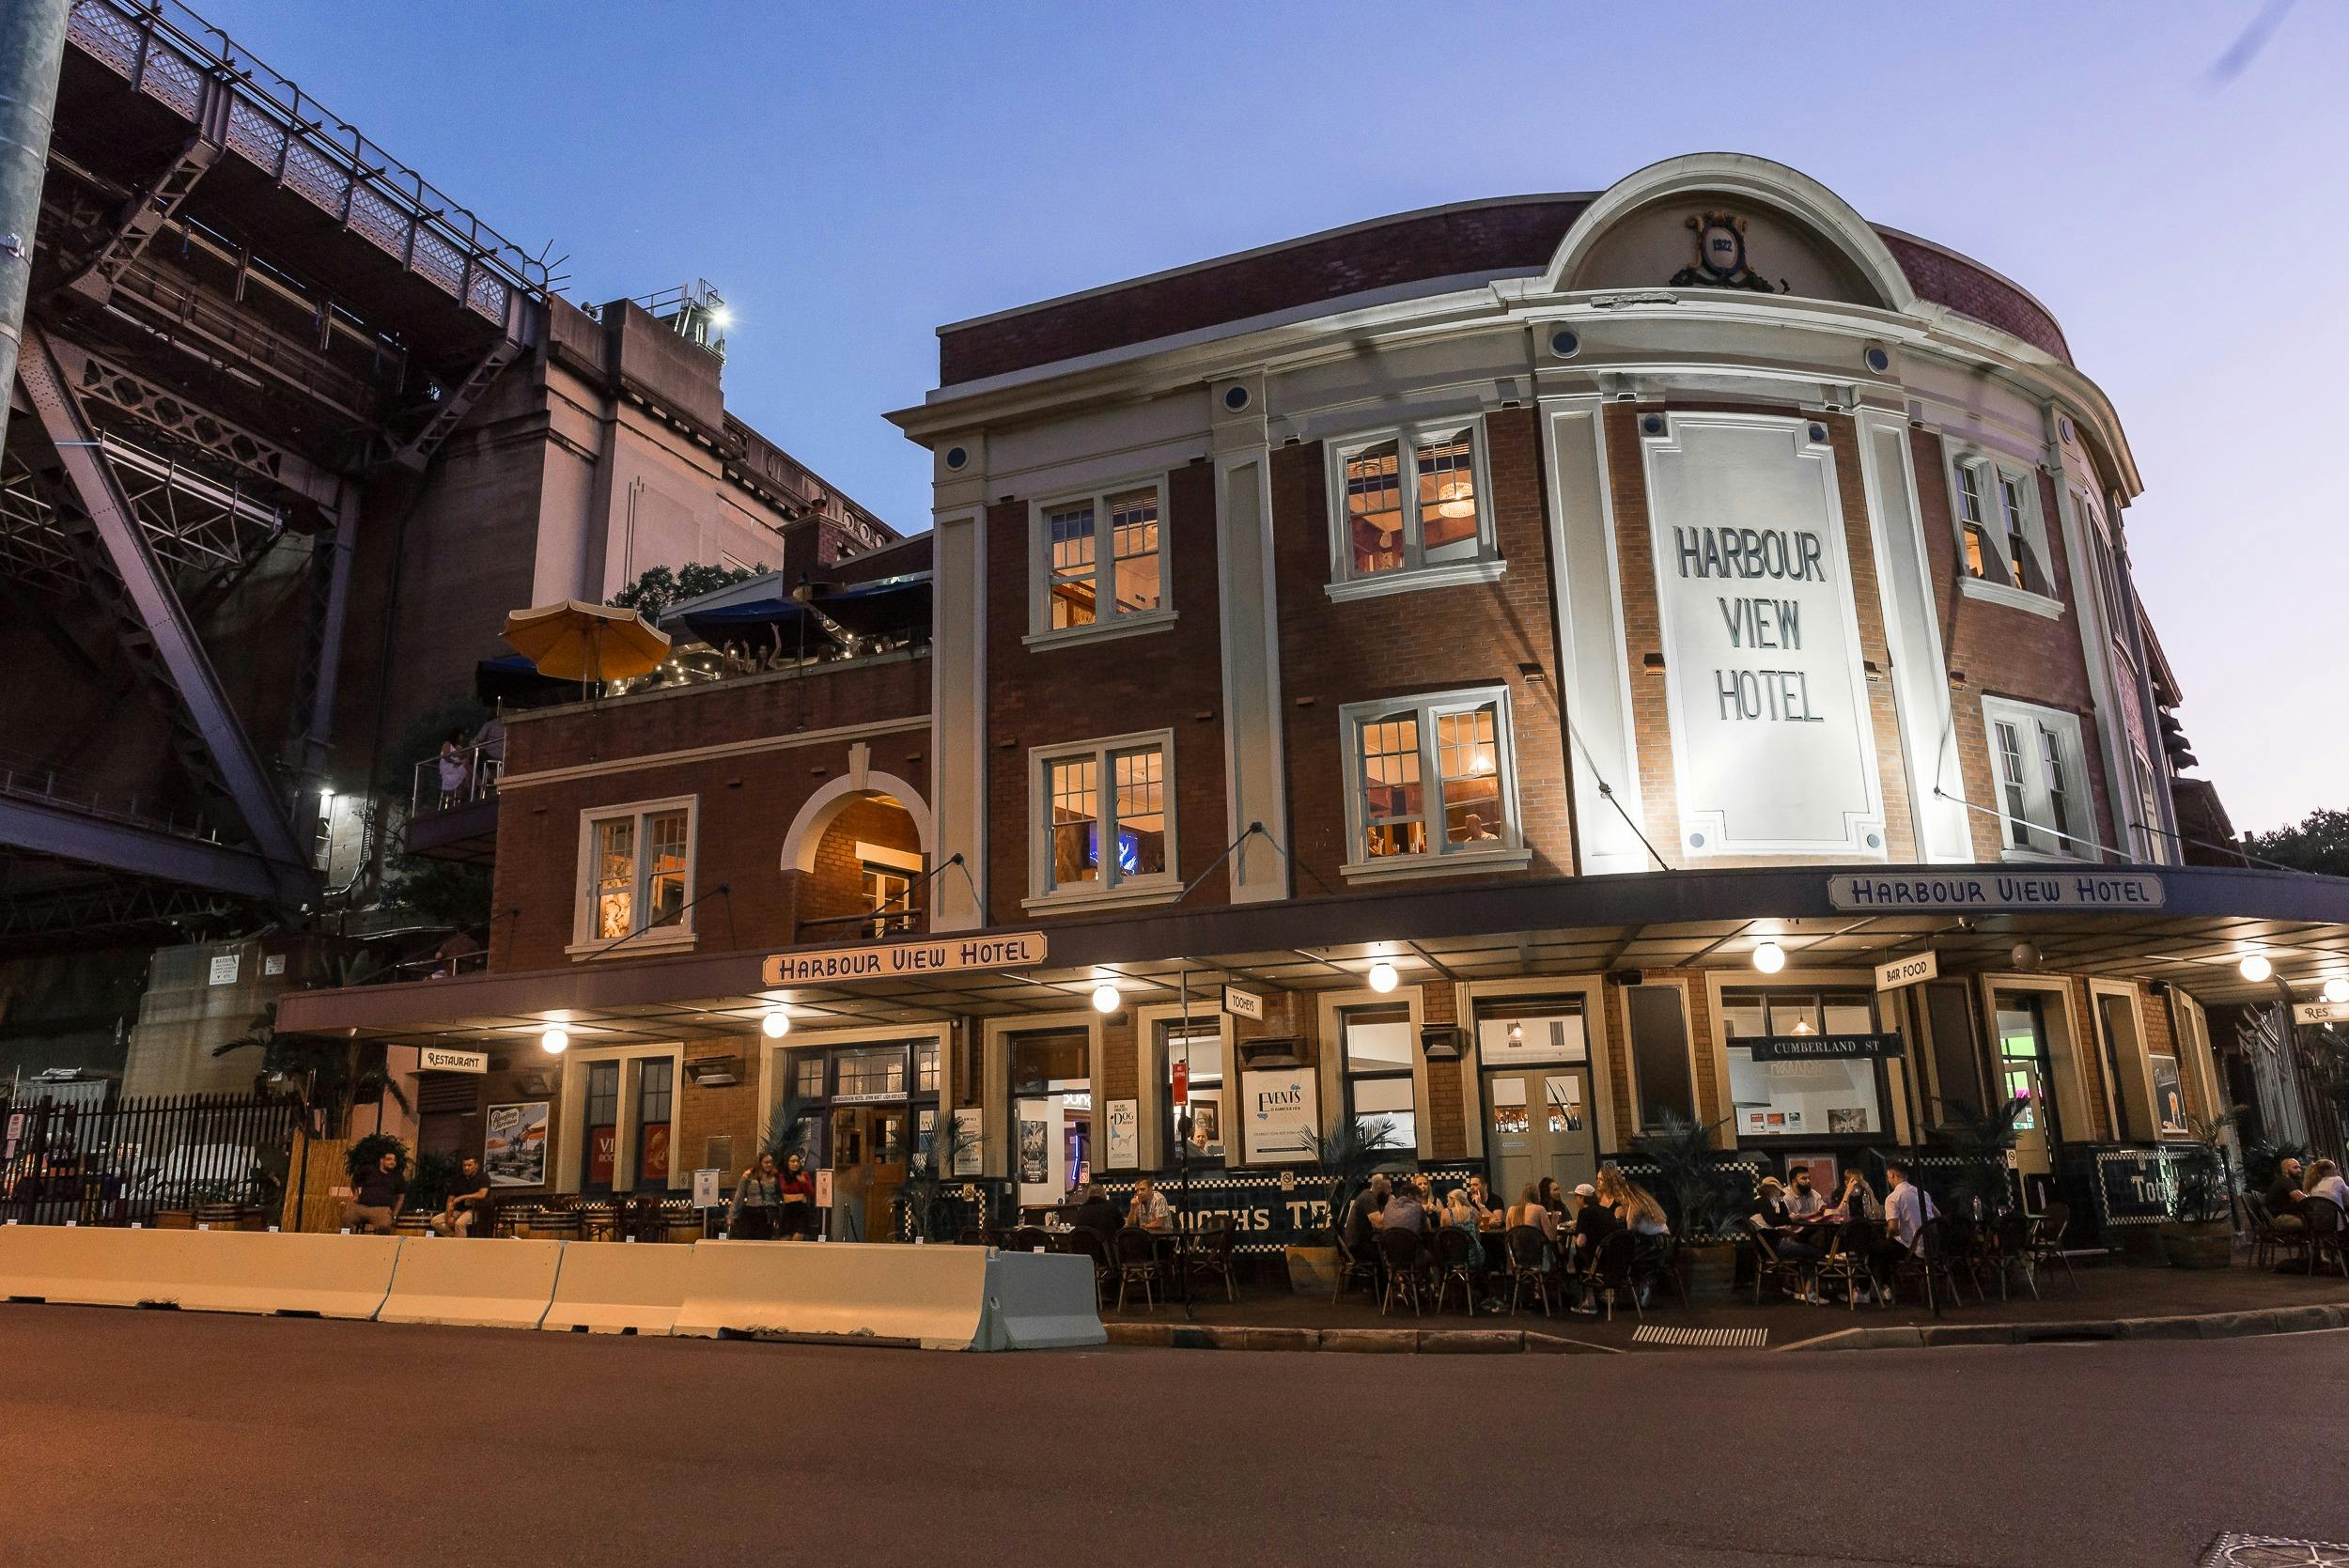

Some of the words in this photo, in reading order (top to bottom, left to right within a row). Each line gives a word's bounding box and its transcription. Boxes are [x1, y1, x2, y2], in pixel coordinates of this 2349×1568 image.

[1672, 525, 1826, 582] HARBOUR
[1717, 597, 1800, 649] VIEW
[1715, 670, 1825, 722] HOTEL
[1851, 879, 1986, 904] HARBOUR
[1997, 878, 2060, 903] VIEW
[2077, 878, 2150, 903] HOTEL
[779, 954, 881, 980] HARBOUR
[893, 948, 946, 971] VIEW
[960, 940, 1031, 965] HOTEL
[1887, 970, 1901, 983] BAR
[1903, 961, 1927, 978] FOOD
[1233, 994, 1254, 1012] TOOHEYS
[1774, 1040, 1856, 1054] CUMBERLAND
[1865, 1040, 1880, 1051] ST
[428, 1052, 480, 1068] RESTAURANT
[1258, 1090, 1301, 1112] EVENTS
[1113, 1111, 1134, 1126] DOG
